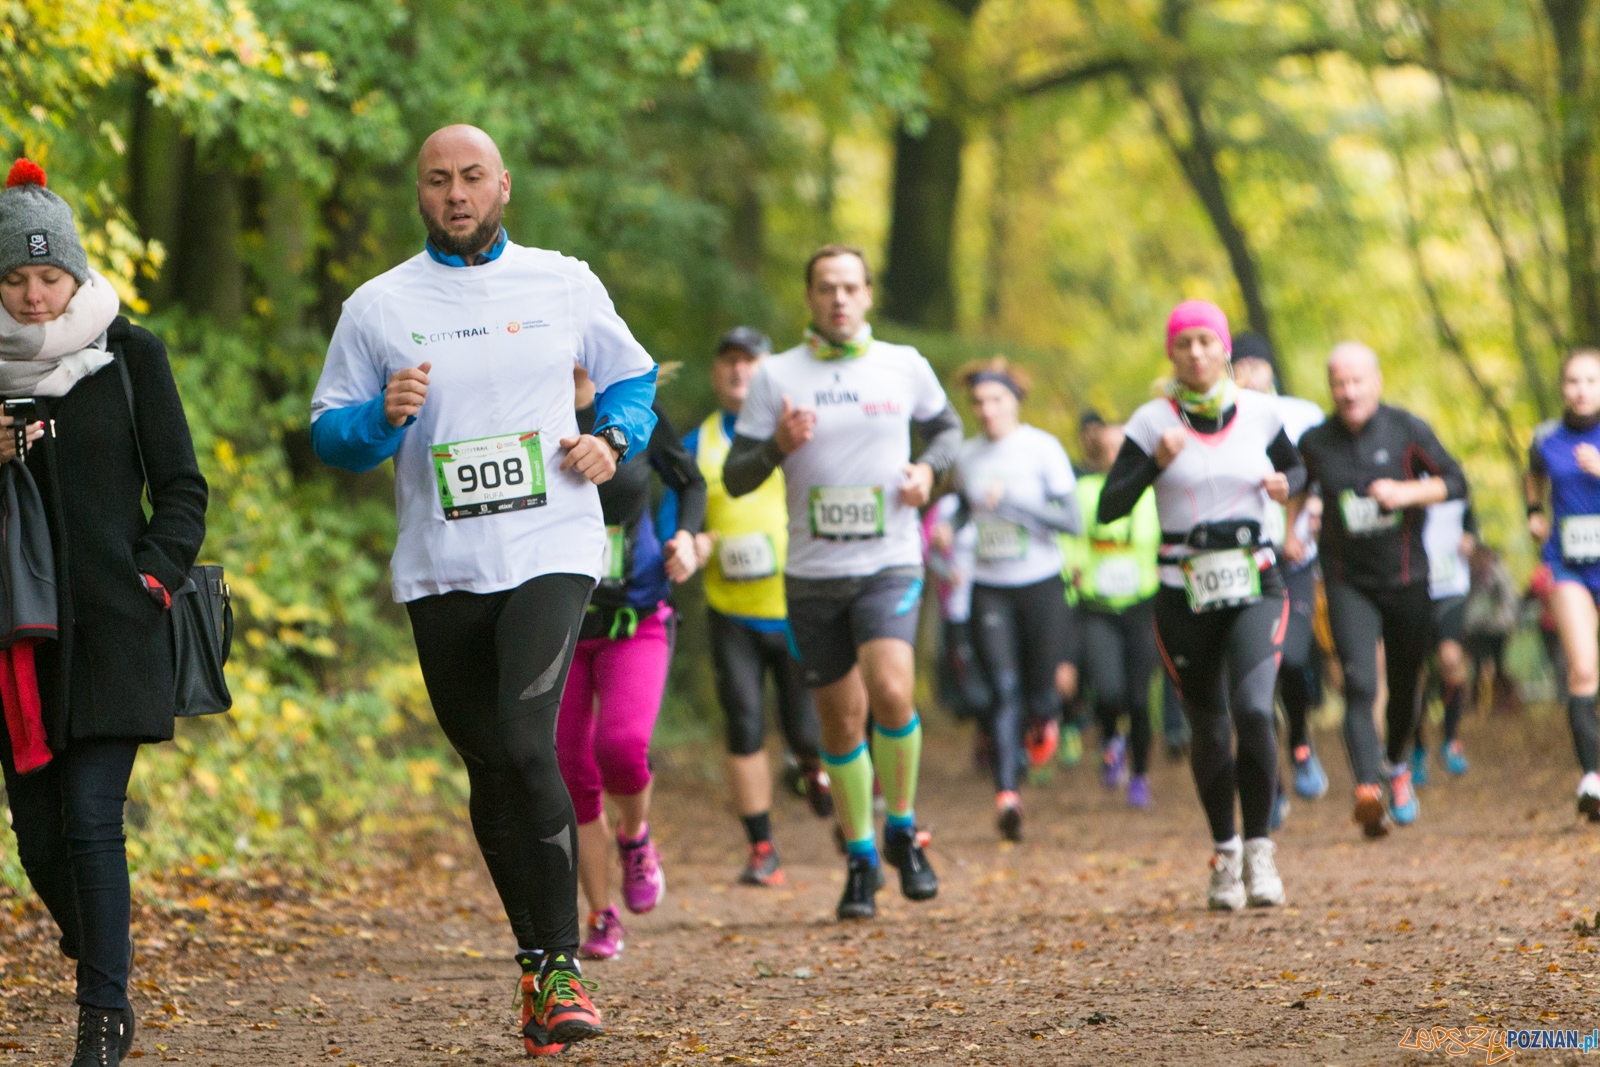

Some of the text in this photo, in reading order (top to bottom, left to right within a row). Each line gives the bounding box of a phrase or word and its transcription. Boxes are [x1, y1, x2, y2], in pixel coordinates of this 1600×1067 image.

[814, 390, 859, 406] RUN
[457, 457, 524, 493] 908
[483, 491, 504, 500] RUFA
[821, 503, 875, 525] 1098
[1196, 566, 1248, 596] 1099
